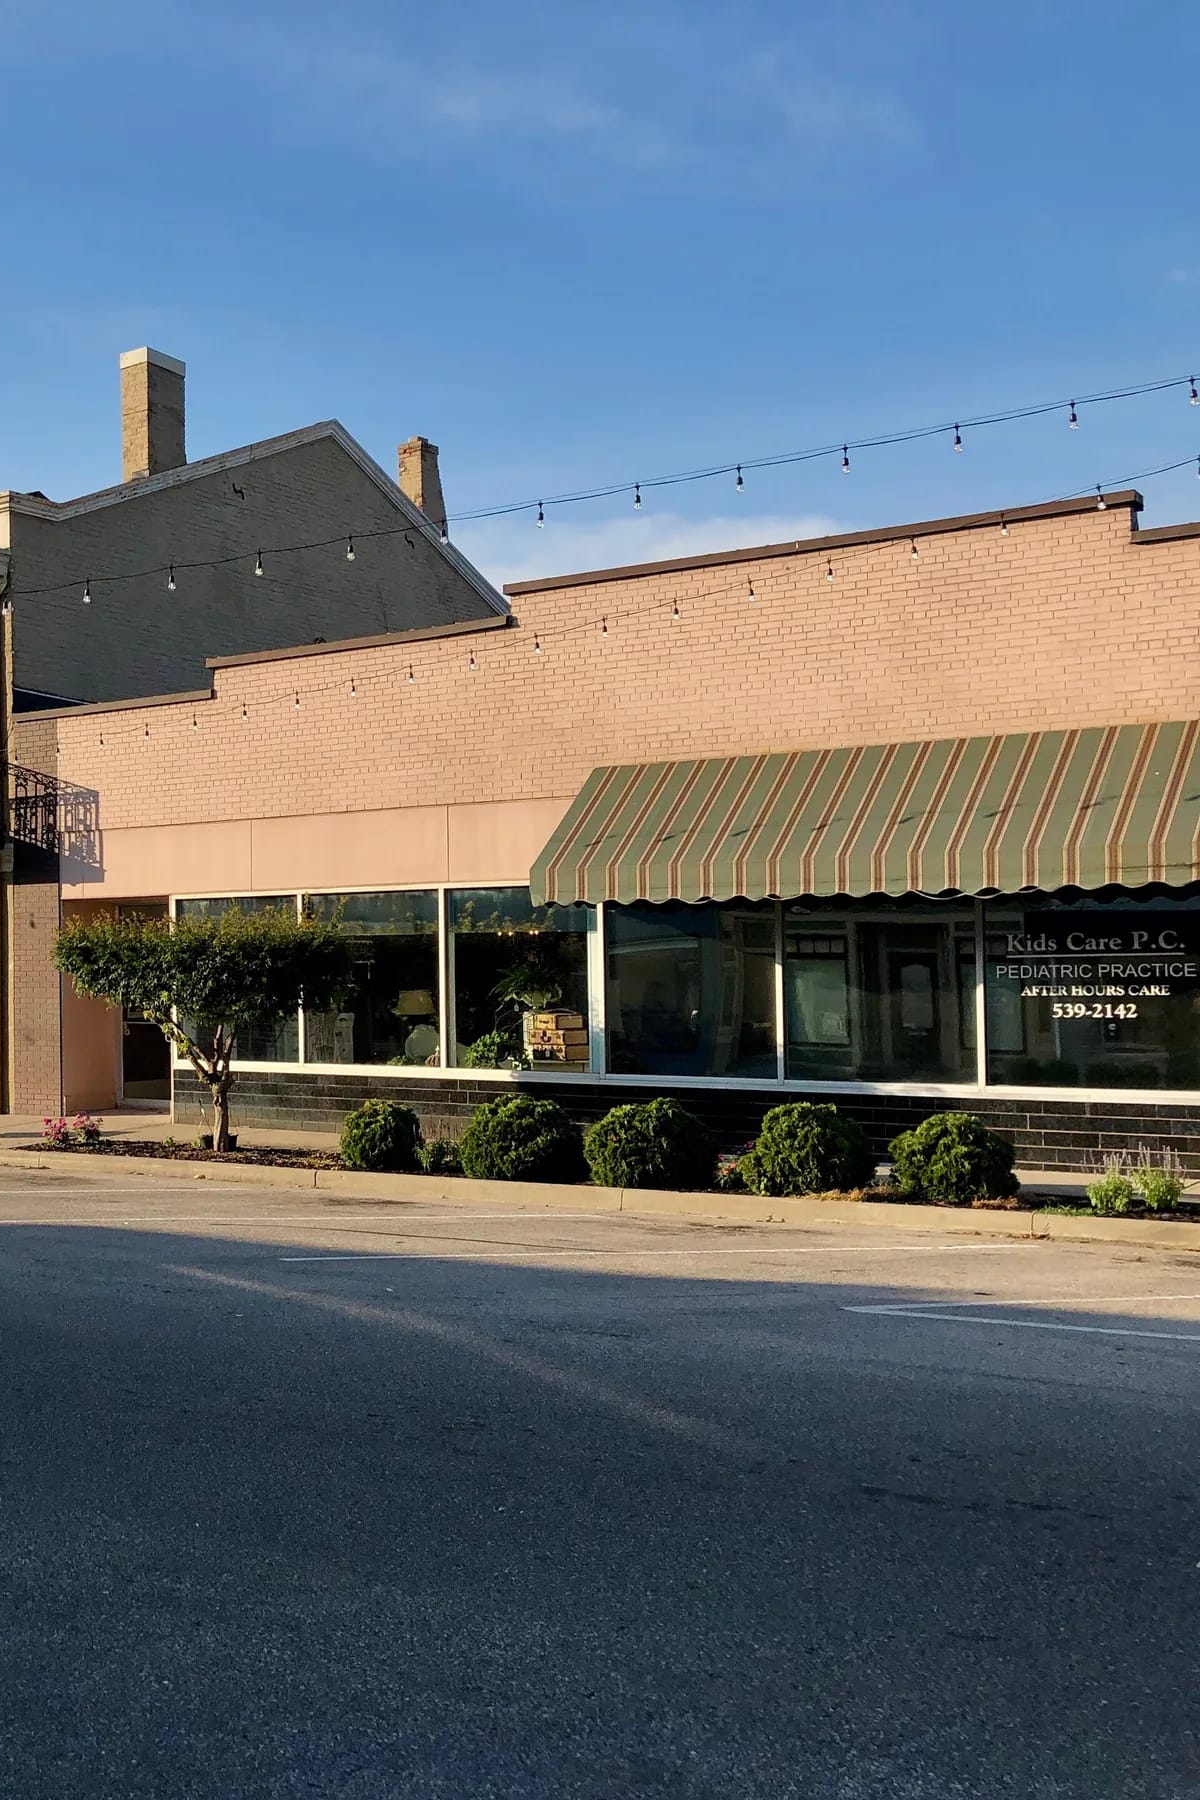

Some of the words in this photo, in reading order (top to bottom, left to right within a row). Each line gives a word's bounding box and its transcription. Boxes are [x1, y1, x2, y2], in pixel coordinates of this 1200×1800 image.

[1006, 933, 1057, 952] Kids
[1066, 932, 1122, 951] Care
[1131, 930, 1186, 950] P.C.
[996, 964, 1092, 979] PEDIATRIC
[1098, 962, 1197, 978] PRACTICE
[1021, 985, 1068, 997] AFTER
[1071, 985, 1125, 996] HOURS
[1128, 984, 1171, 996] CARE
[1052, 1003, 1138, 1019] 539-2142
